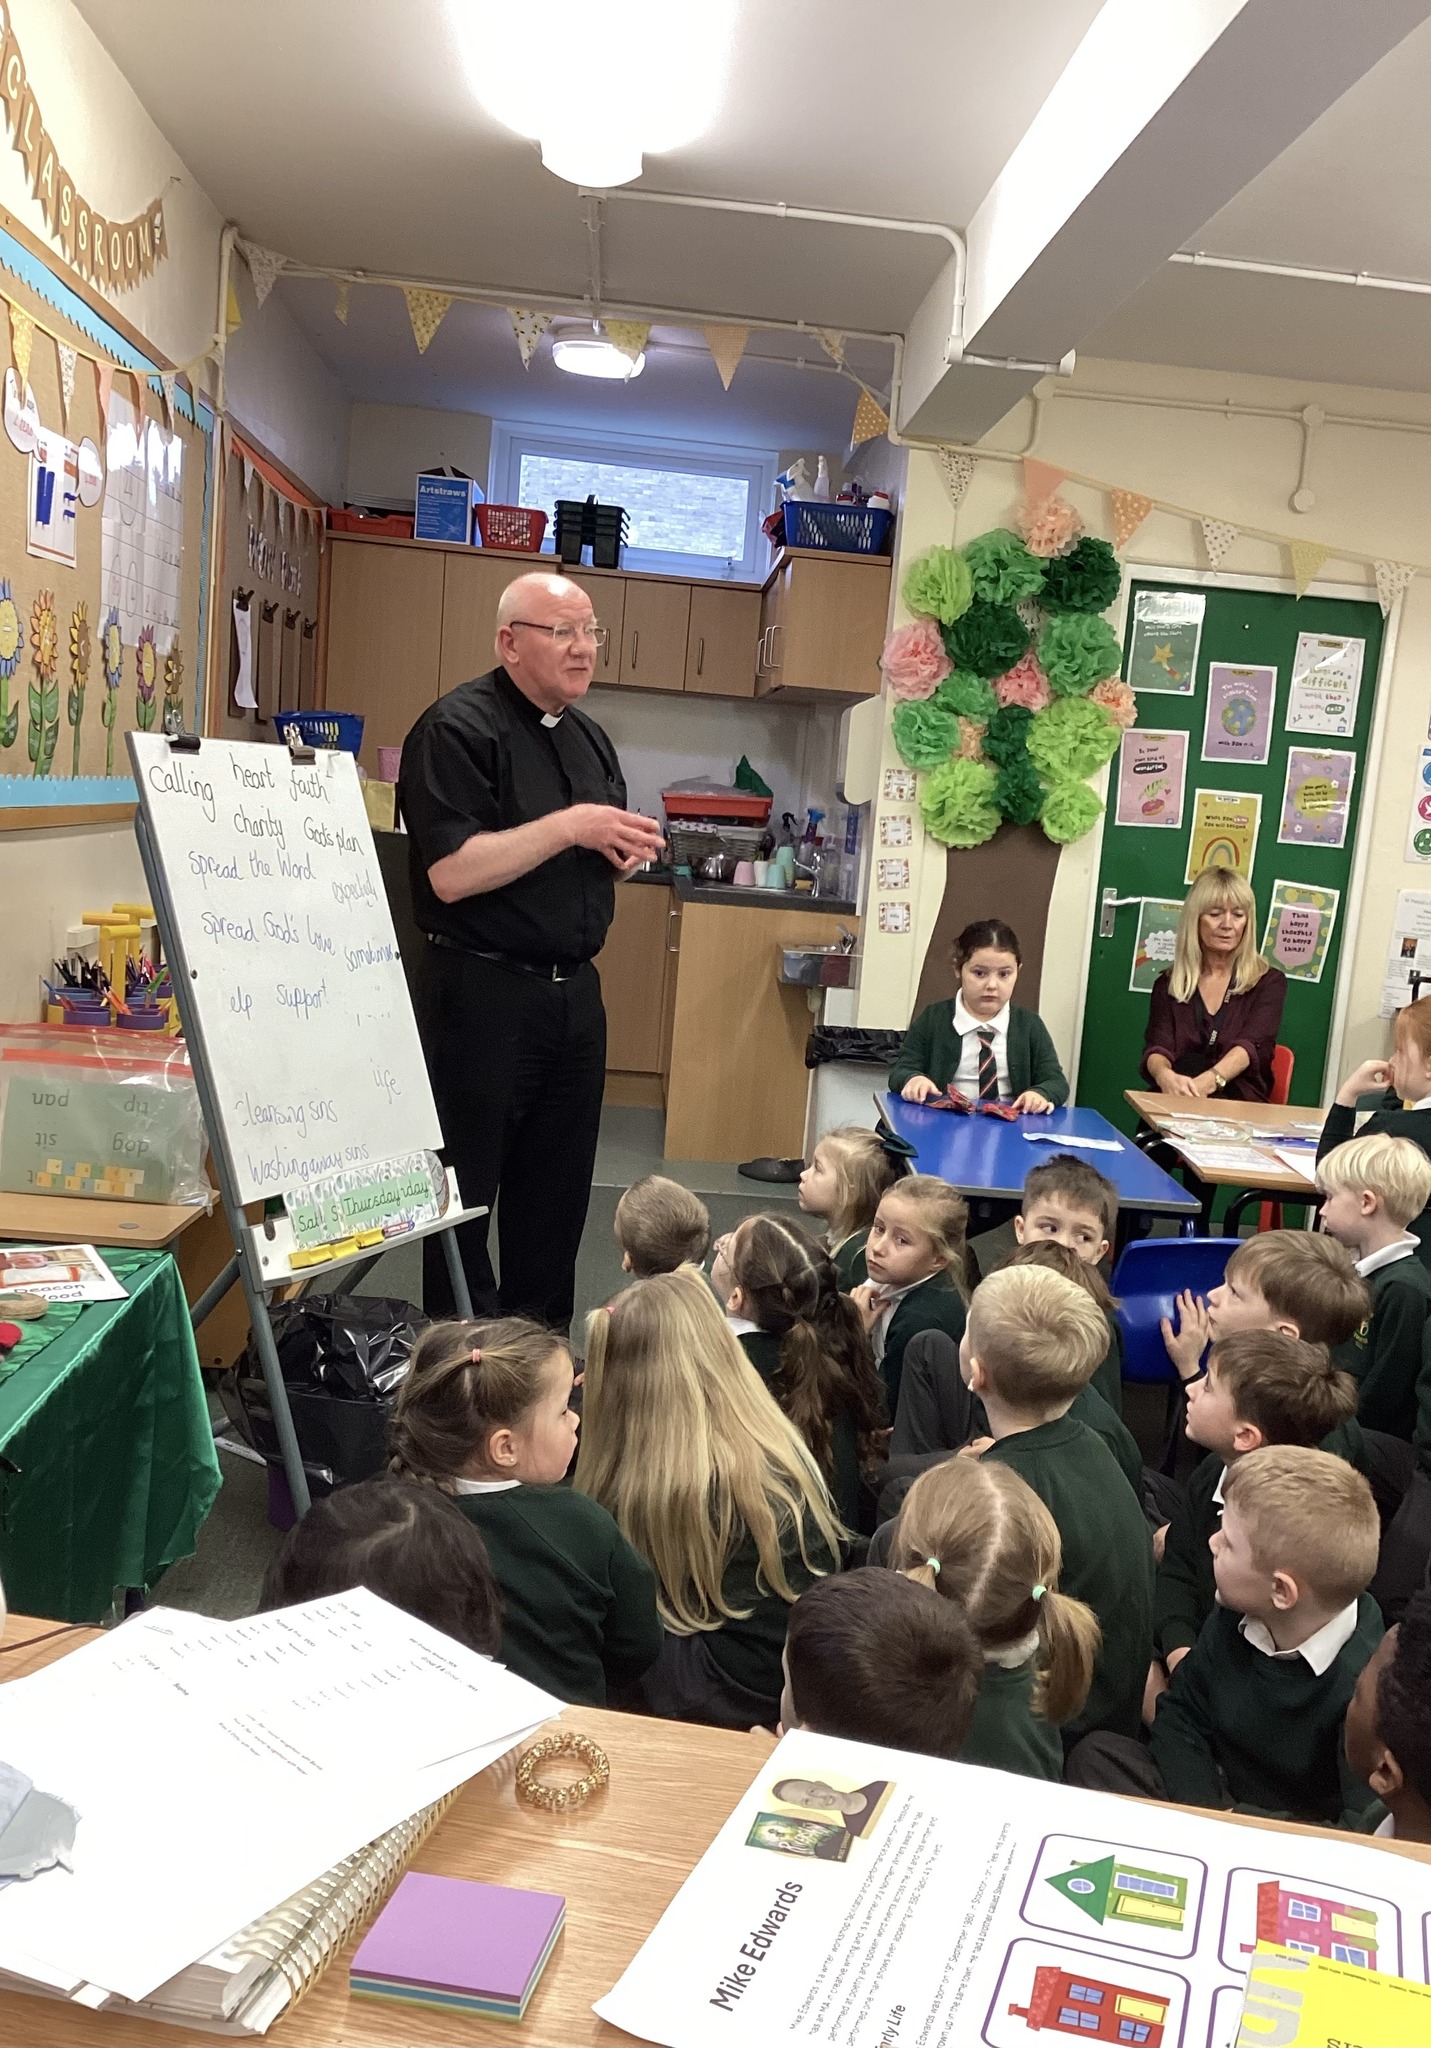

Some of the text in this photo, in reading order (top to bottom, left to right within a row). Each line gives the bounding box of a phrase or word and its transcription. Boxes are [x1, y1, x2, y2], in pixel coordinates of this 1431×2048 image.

[420, 485, 467, 497] Artstraws
[1301, 676, 1349, 690] difficult
[150, 753, 330, 822] Calling heart faith
[234, 805, 286, 850] charity
[336, 827, 364, 856] plan
[188, 850, 316, 889] Spread the Word
[201, 911, 259, 944] Spread
[32, 1088, 149, 1116] pan tip
[35, 1131, 149, 1158] sit dog
[343, 1190, 401, 1217] Thursday
[42, 1290, 84, 1300] ood
[987, 1894, 1000, 1913] called
[978, 1913, 992, 1937] brother
[709, 1881, 802, 2011] Mike Edwards
[972, 1941, 983, 1953] had
[797, 1985, 819, 2014] Edwards
[831, 1921, 850, 1952] workshop
[845, 2010, 868, 2046] performed
[862, 1996, 873, 2009] one
[868, 1980, 879, 1994] man
[876, 1958, 890, 1978] shows
[885, 1942, 896, 1957] even
[892, 1913, 912, 1942] appearing
[808, 2023, 820, 2034] has
[818, 2002, 830, 2012] MA
[830, 1967, 848, 1993] creative
[843, 1944, 860, 1966] writing
[853, 1931, 864, 1944] and
[827, 2005, 849, 2041] performed
[848, 1975, 864, 1997] poetry
[858, 1961, 870, 1974] and
[864, 1938, 878, 1961] spoken
[876, 1922, 887, 1937] word
[915, 2014, 935, 2046] Edwards
[930, 1999, 941, 2013] was
[948, 1929, 967, 1962] September
[954, 1982, 967, 2000] same
[886, 2004, 905, 2025] Life
[949, 2001, 960, 2011] the
[944, 2020, 953, 2030] up
